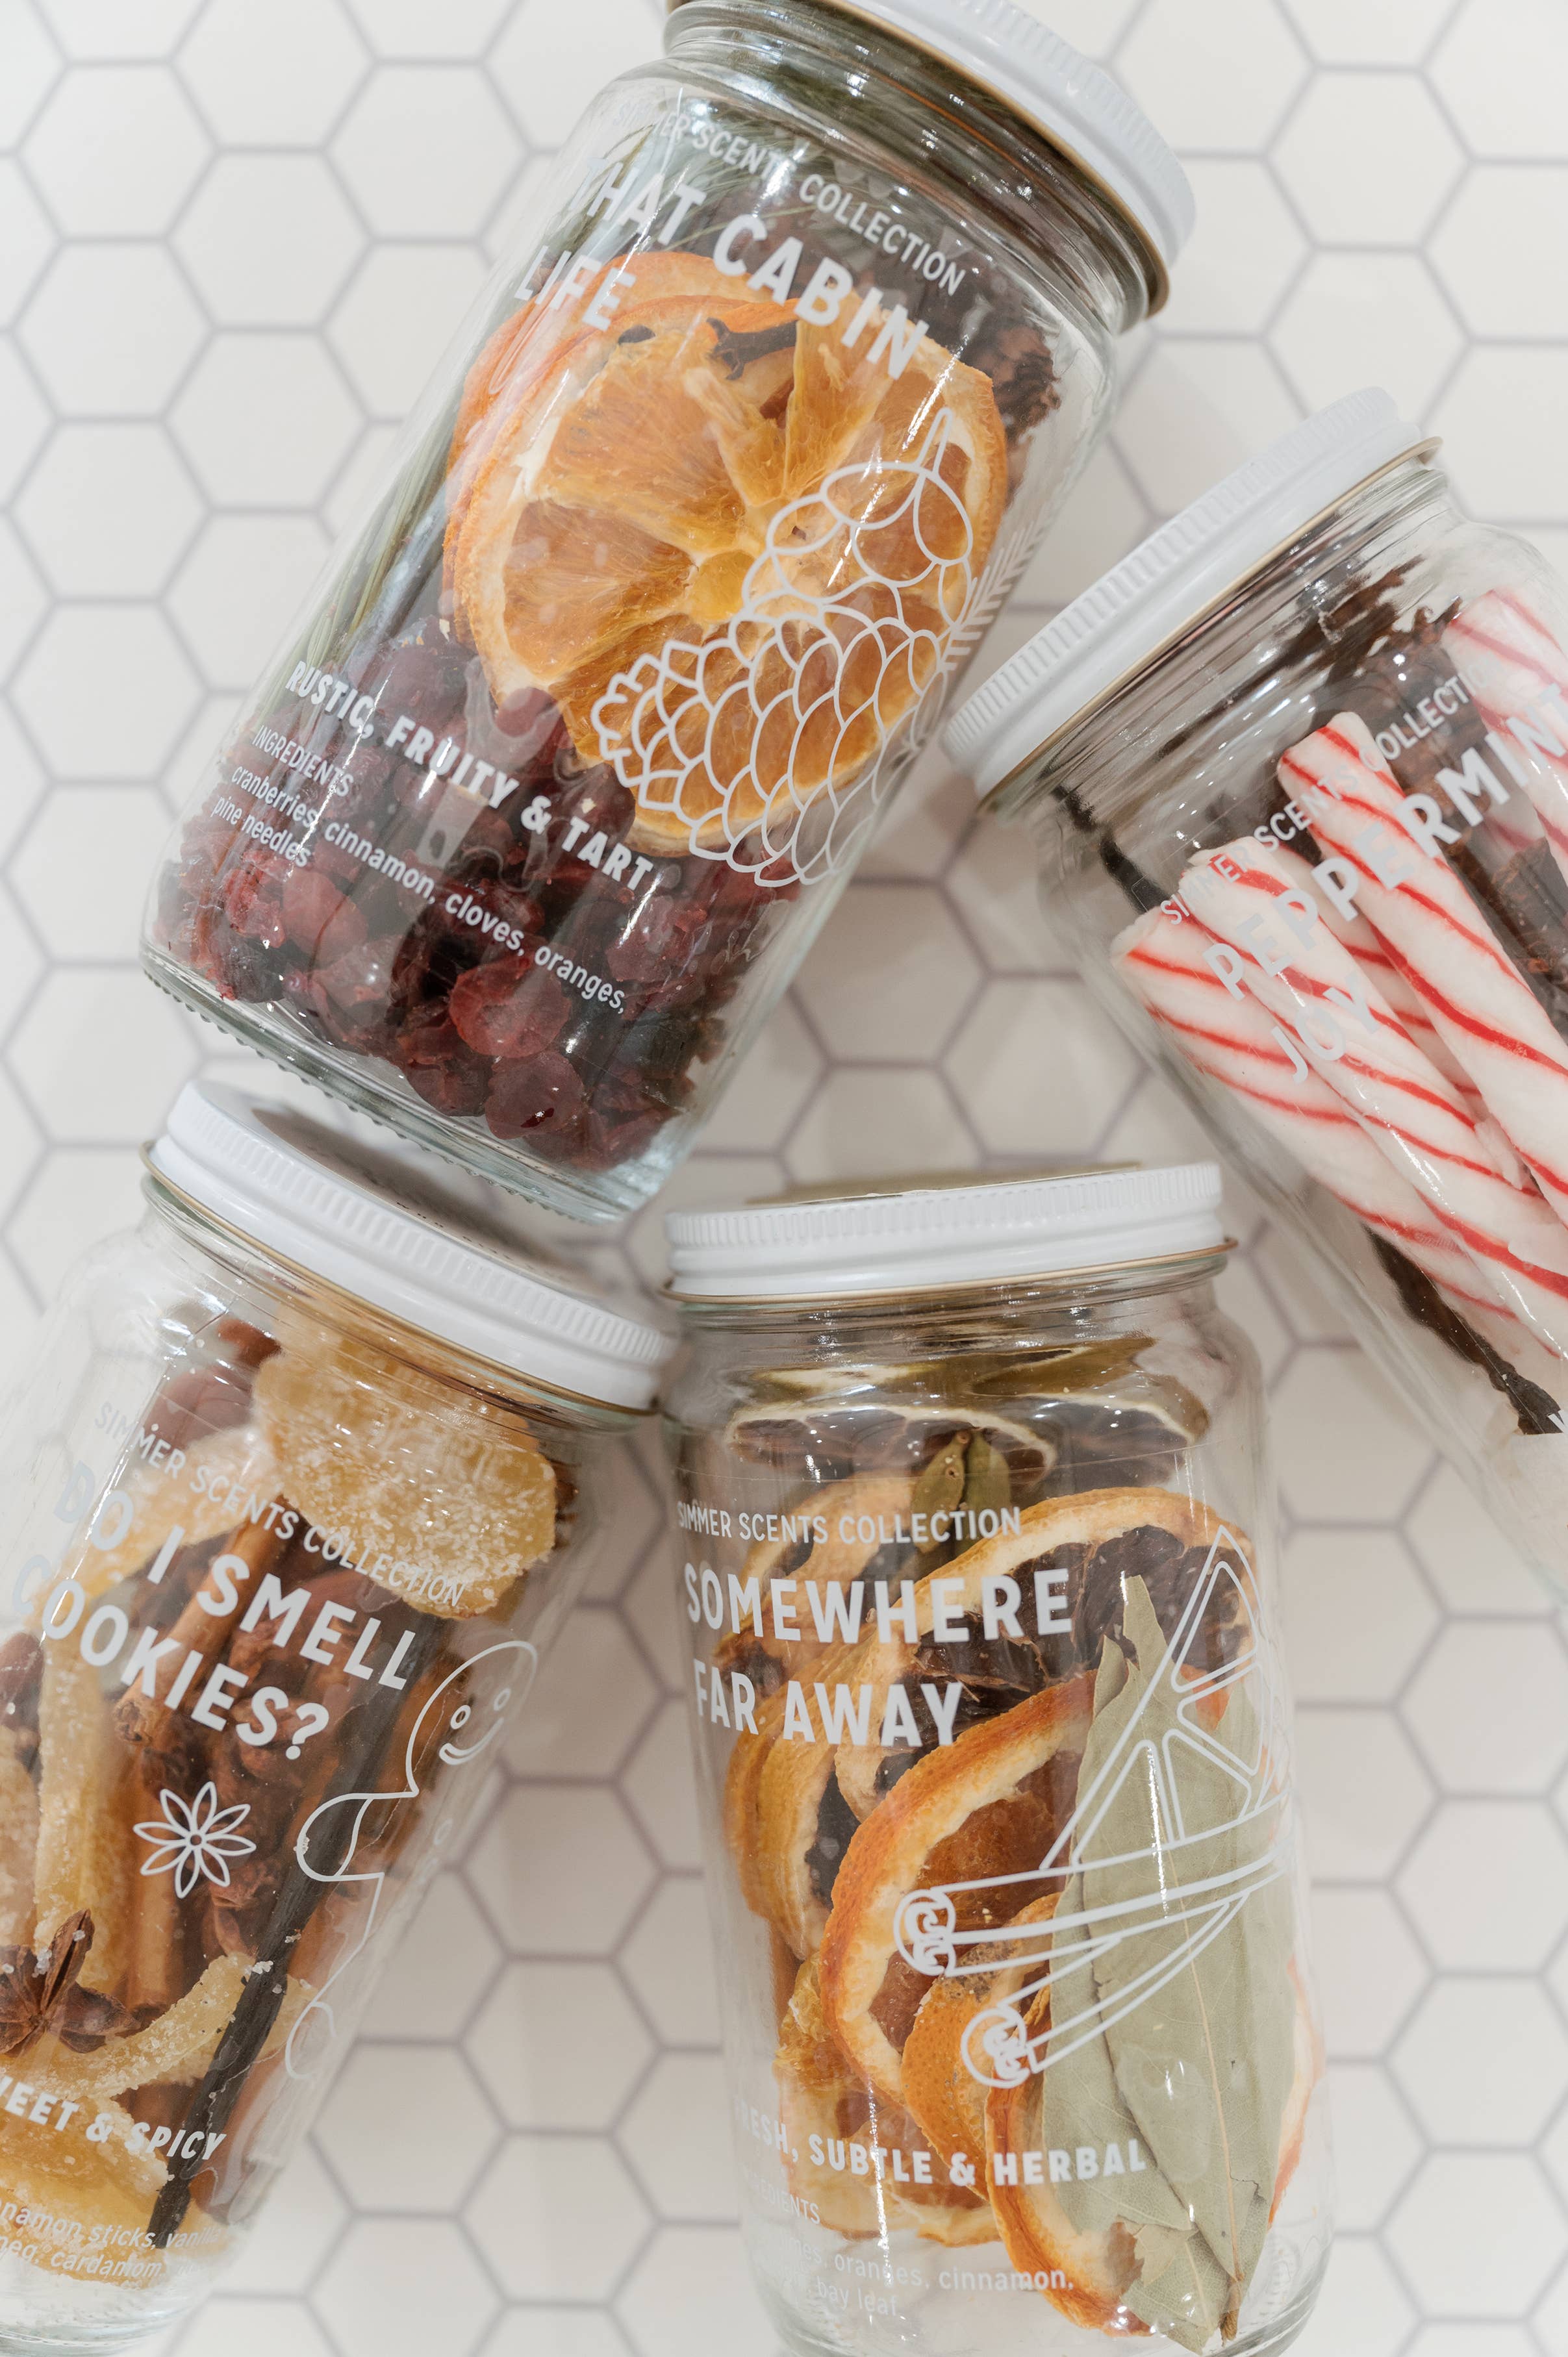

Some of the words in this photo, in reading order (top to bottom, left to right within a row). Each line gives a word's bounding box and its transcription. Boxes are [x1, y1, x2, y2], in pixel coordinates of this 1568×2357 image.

[568, 157, 707, 246] THAT
[714, 214, 929, 381] CABIN
[799, 173, 966, 296] COLLECTION
[514, 245, 637, 332] LIFE
[251, 725, 354, 798] INGREDIENTS
[285, 660, 373, 738] RUSTIC,
[386, 714, 519, 809] FRUITY
[521, 796, 552, 835] &
[560, 816, 653, 891] TART
[1254, 764, 1358, 852] SCENTS
[1359, 651, 1510, 771] COLLECTIO
[210, 796, 242, 826] pine
[241, 814, 311, 867] needles
[325, 821, 436, 904] cinnamon,
[444, 892, 525, 957] cloves,
[534, 945, 625, 1014] oranges,
[1271, 972, 1378, 1083] JOY
[94, 1401, 187, 1479] SIMMER
[190, 1465, 300, 1540] SCENTS
[303, 1524, 466, 1607] COLLECTION
[677, 1500, 732, 1539] SIMMER
[739, 1512, 828, 1544] SCENTS
[839, 1506, 1020, 1544] COLLECTION
[53, 1459, 134, 1552] DO
[147, 1525, 185, 1585] I
[196, 1554, 416, 1691] SMELL
[684, 1562, 1072, 1644] SOMEWHERE
[12, 1554, 330, 1761] COOKIES?
[693, 1658, 759, 1735] FAR
[783, 1680, 963, 1747] AWAY
[86, 2113, 114, 2143] &
[125, 2122, 227, 2160] SPICY
[734, 2097, 798, 2162] RESH,
[809, 2134, 933, 2184] SUBTLE
[949, 2152, 975, 2186] &
[994, 2139, 1147, 2186] HERBAL
[0, 2199, 82, 2238] namon
[88, 2225, 156, 2250] sticks,
[816, 2275, 849, 2310] bay
[857, 2287, 898, 2317] leaf
[939, 2266, 1074, 2291] cinnamon,
